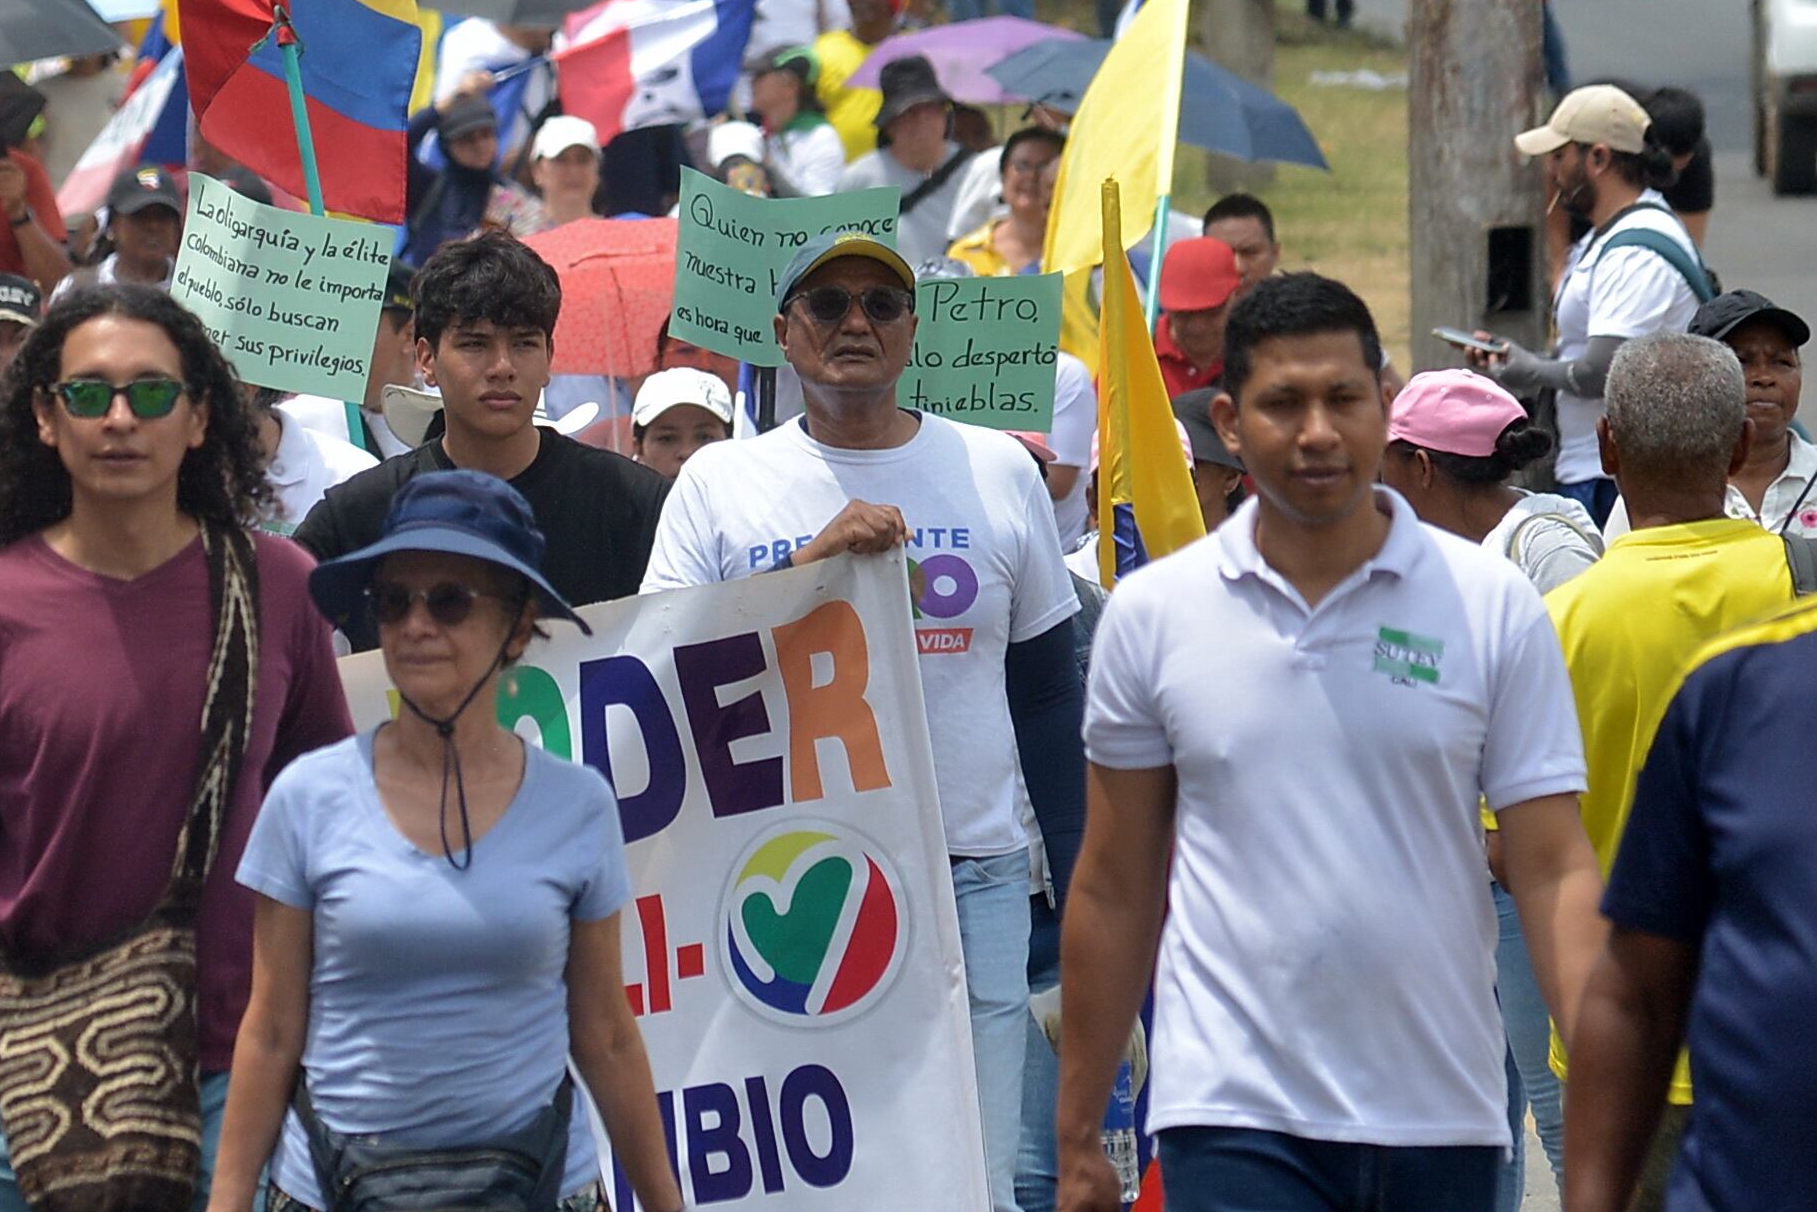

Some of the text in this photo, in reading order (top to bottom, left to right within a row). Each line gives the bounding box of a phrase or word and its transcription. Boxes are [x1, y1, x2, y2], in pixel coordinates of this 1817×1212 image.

[690, 193, 765, 248] Quien
[775, 230, 809, 248] no
[303, 244, 316, 266] y
[321, 232, 338, 258] la
[342, 237, 390, 266] élite
[265, 268, 289, 286] no
[295, 269, 313, 290] le
[319, 276, 385, 304] importa
[685, 250, 756, 295] nuestra
[268, 302, 340, 333] buscan
[677, 305, 763, 346] es hora que
[234, 335, 265, 356] sus
[268, 344, 366, 377] privilegios.
[951, 337, 1058, 377] despertó
[909, 378, 1039, 415] tinieblas.
[919, 633, 965, 651] VIDA
